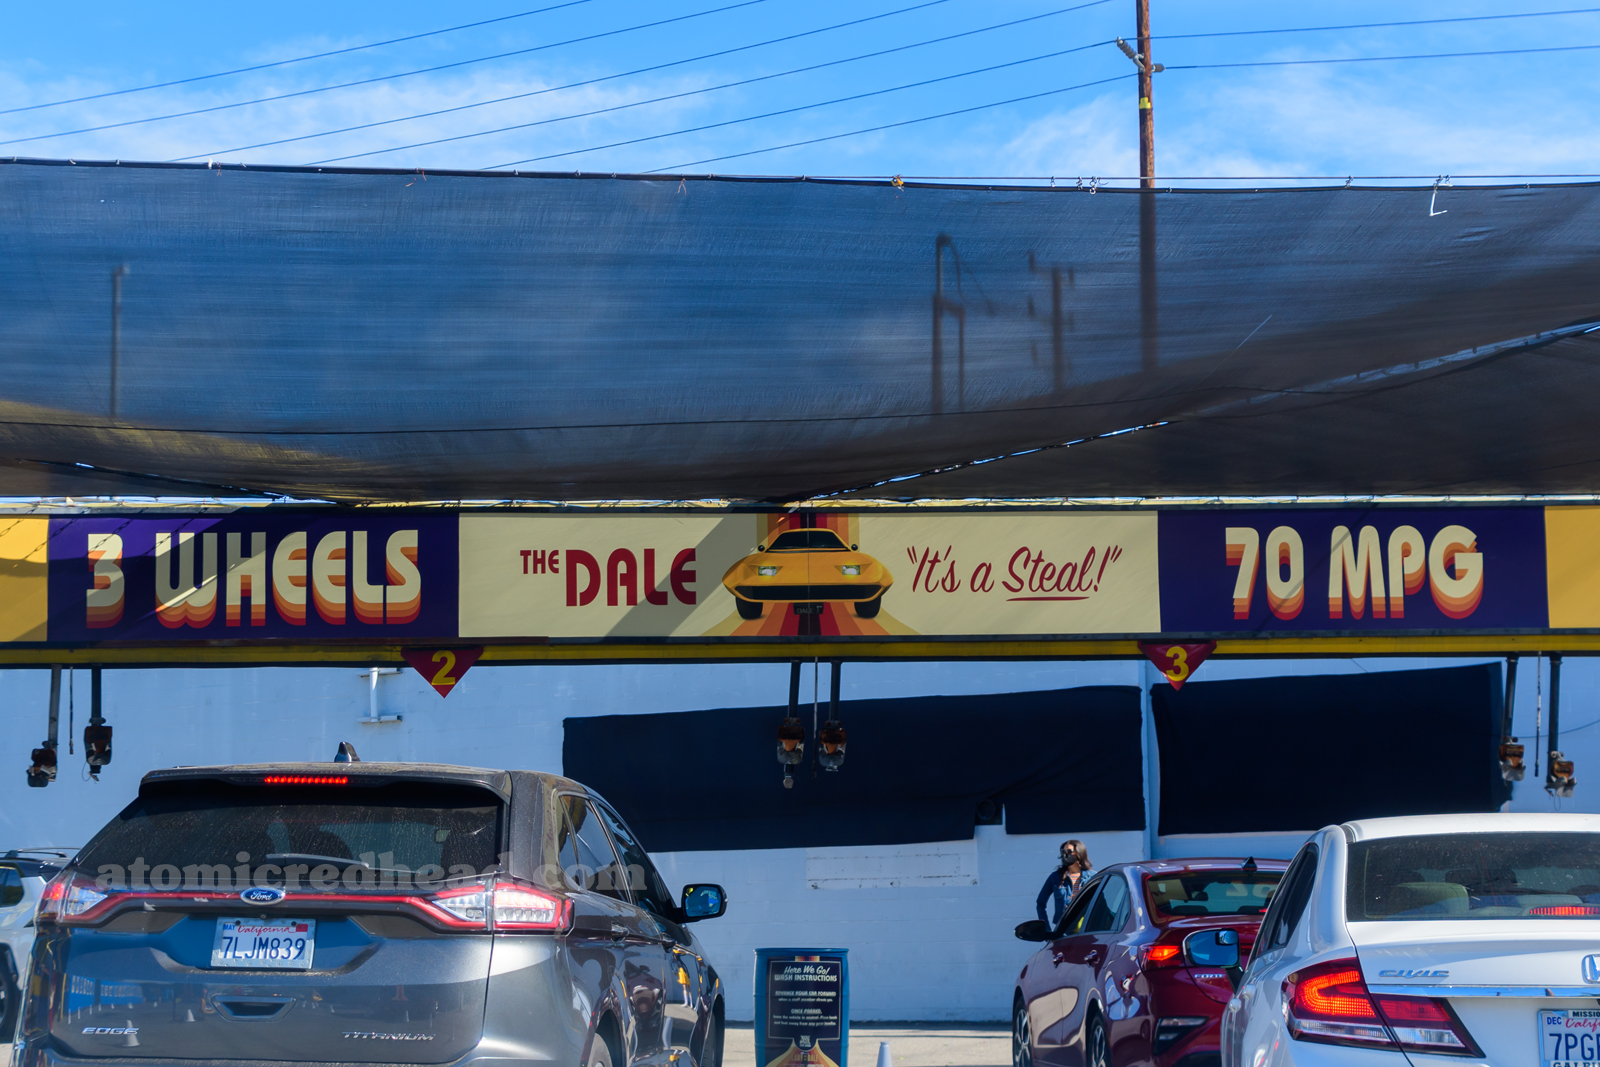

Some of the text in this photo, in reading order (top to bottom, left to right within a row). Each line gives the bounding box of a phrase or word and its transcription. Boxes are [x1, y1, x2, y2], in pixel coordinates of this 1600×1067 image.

[520, 548, 697, 607] THE DALE
[970, 562, 995, 593] a
[1225, 525, 1484, 620] 70 MPG
[86, 530, 421, 629] 3 WHEELS
[431, 650, 456, 686] 2
[1165, 646, 1190, 681] 3
[250, 890, 273, 900] Ford
[237, 925, 297, 937] California
[222, 936, 306, 960] 7LJM839
[784, 965, 831, 975] Here We Go!
[1378, 969, 1450, 979] CIVIC
[794, 974, 838, 982] INSTRUCTIONS
[1546, 1016, 1562, 1025] DEC
[81, 1026, 139, 1035] EDGE
[342, 1031, 436, 1040] TITANIUM
